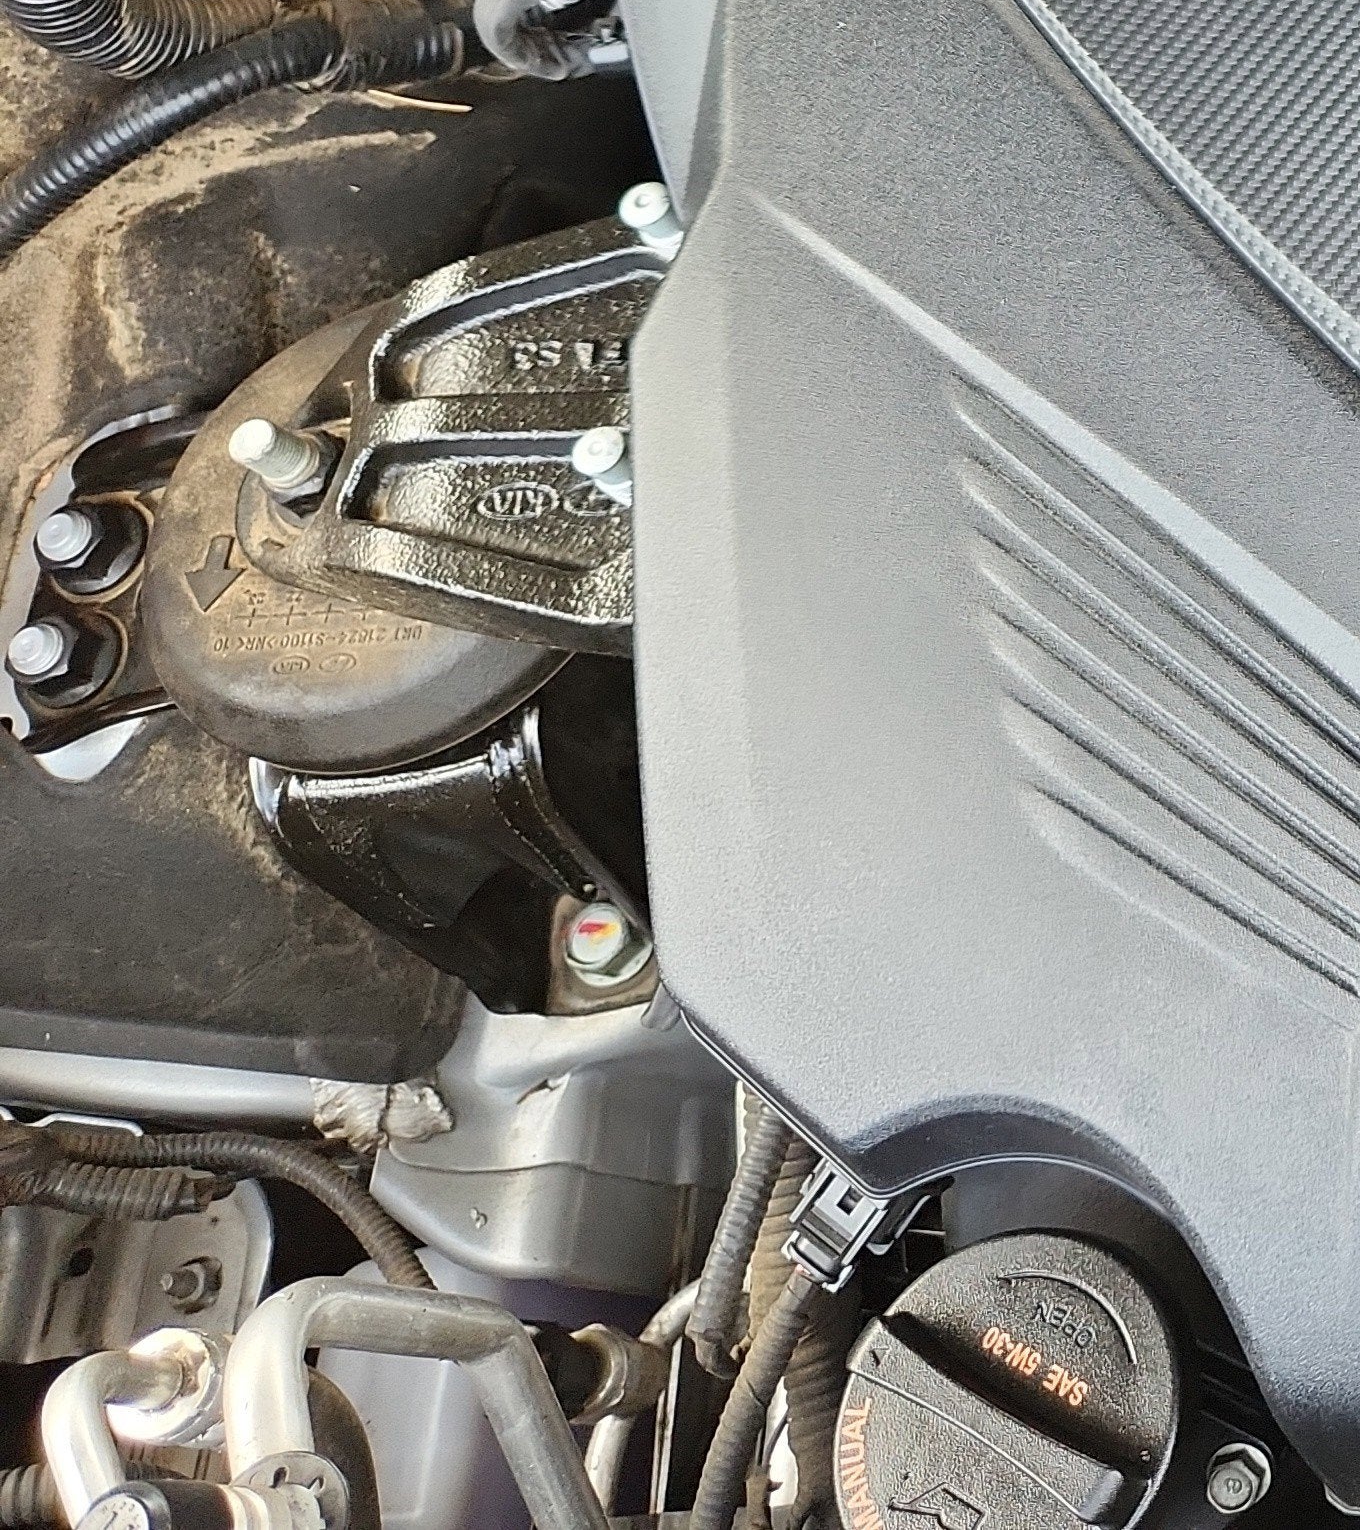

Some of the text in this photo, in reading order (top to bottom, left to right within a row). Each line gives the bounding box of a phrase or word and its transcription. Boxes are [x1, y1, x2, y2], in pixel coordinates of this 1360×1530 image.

[1032, 1301, 1098, 1348] OPEN
[981, 1326, 1089, 1406] SAE 5W-30
